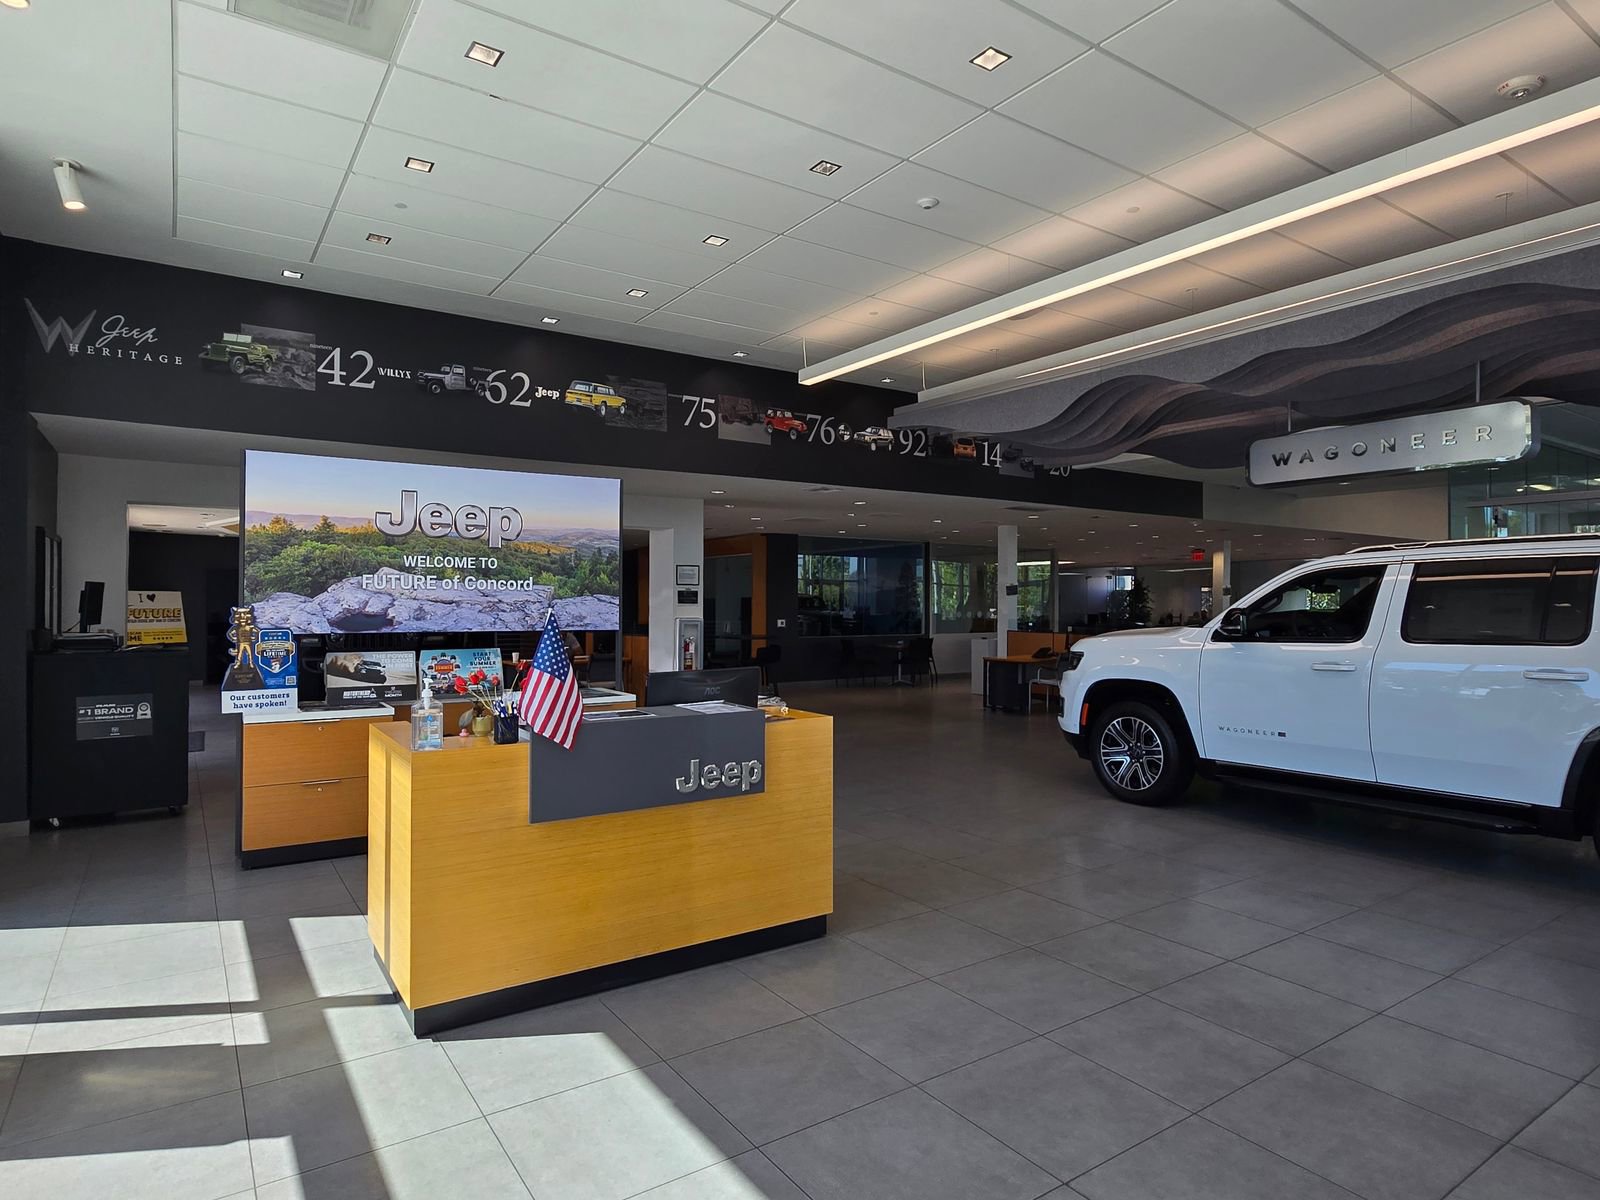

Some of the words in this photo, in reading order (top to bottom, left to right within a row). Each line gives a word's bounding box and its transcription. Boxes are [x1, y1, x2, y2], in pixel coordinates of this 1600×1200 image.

[96, 315, 158, 347] Jeep
[69, 343, 183, 365] HERITAGE
[317, 347, 376, 390] 42
[377, 366, 411, 379] WILLYS
[485, 370, 532, 407] 62
[682, 395, 716, 429] 75
[806, 414, 836, 445] 76
[899, 429, 927, 457] 92
[982, 441, 1002, 468] 14
[1272, 425, 1493, 467] WAGONEER
[375, 489, 523, 548] Jeep
[403, 555, 476, 569] WELCOME
[479, 556, 498, 569] TO
[362, 574, 437, 590] FUTURE
[441, 574, 461, 590] of
[464, 575, 533, 591] Concord
[128, 608, 181, 619] FUTURE
[247, 693, 290, 701] customers
[255, 700, 287, 708] spoken!
[94, 706, 134, 716] BRAND
[1218, 726, 1275, 736] WAGONEER
[675, 758, 762, 793] Jeep
